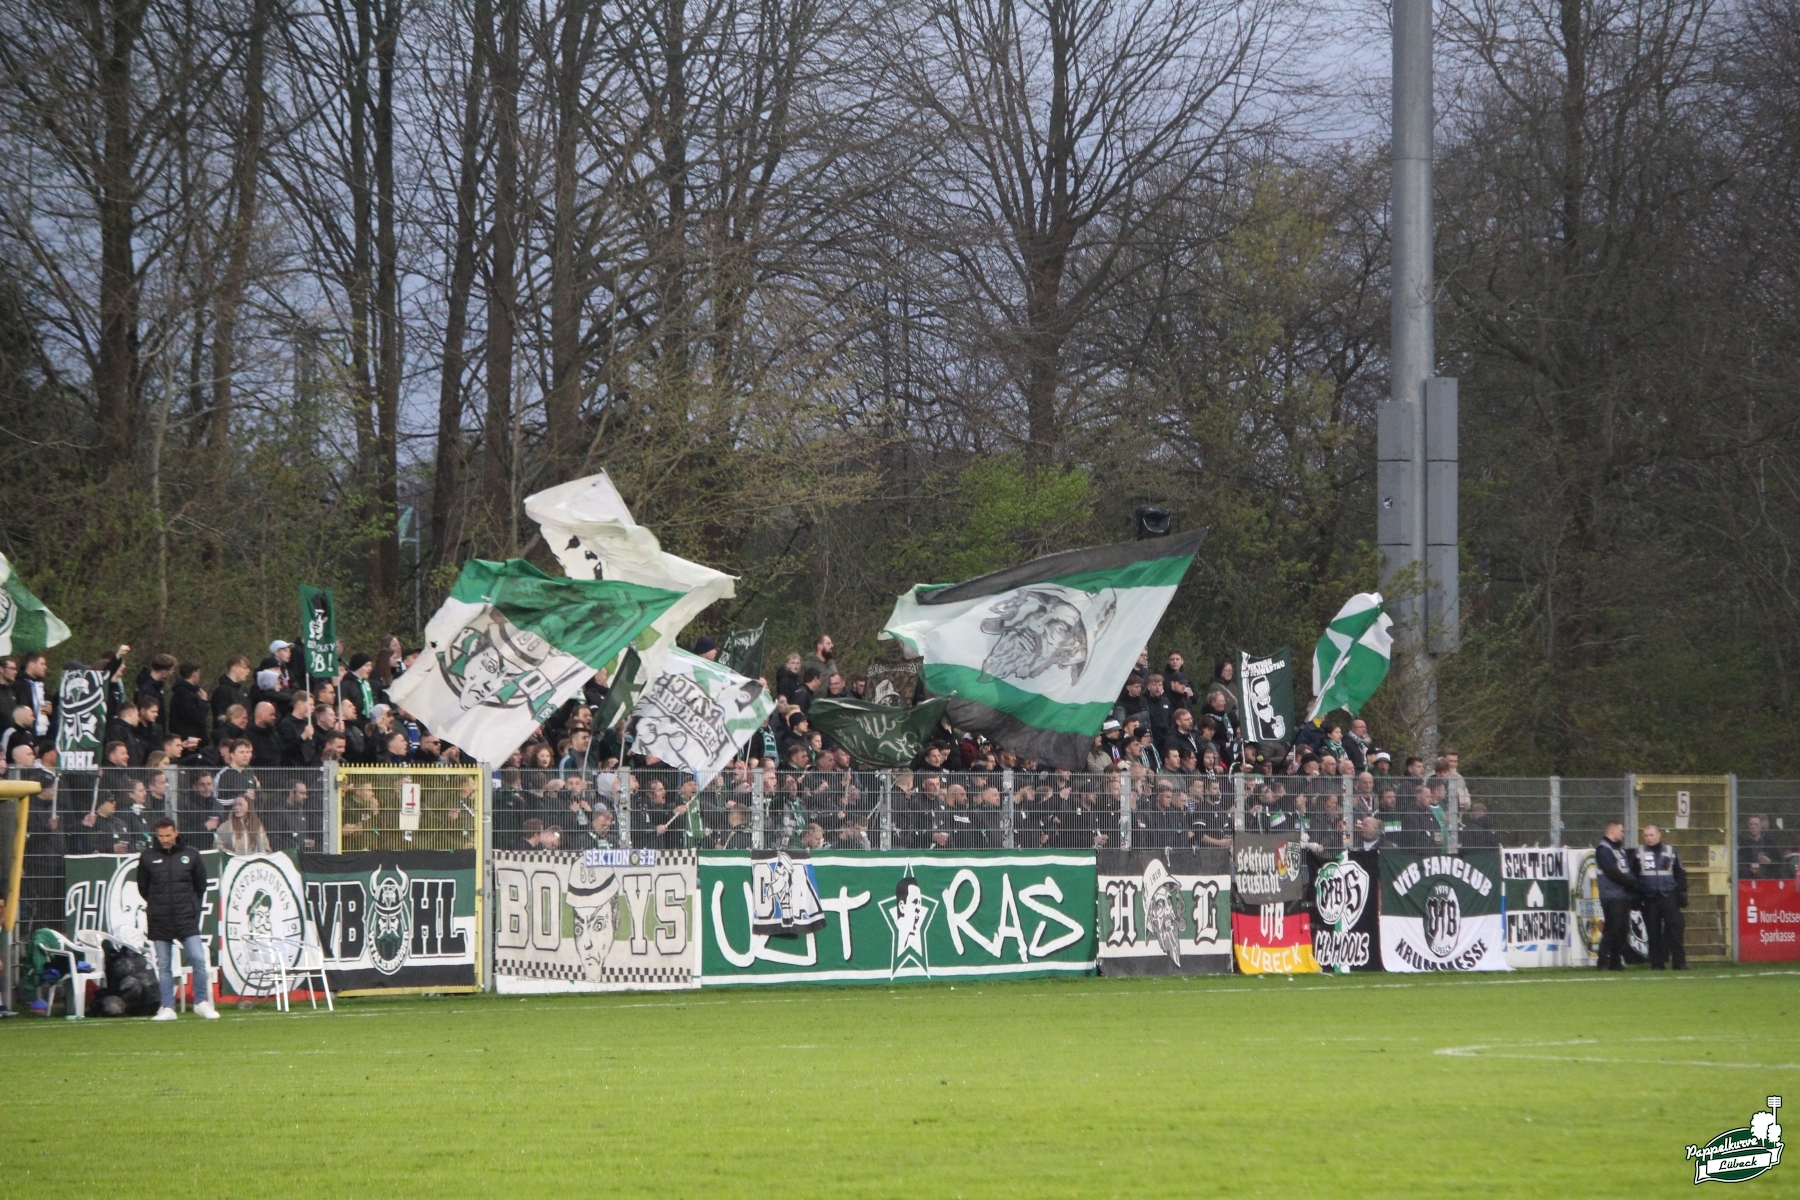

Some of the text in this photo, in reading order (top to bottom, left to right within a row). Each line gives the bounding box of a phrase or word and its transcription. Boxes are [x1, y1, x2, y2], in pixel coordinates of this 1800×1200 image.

[60, 751, 99, 770] VBHL
[1679, 793, 1689, 815] 5
[586, 850, 630, 866] SEKTION
[1238, 846, 1275, 872] sektion
[1644, 860, 1656, 870] 94
[1393, 855, 1493, 896] VfB FANCLUB
[232, 868, 292, 912] KÜSTENJUNGS
[286, 923, 298, 933] 19
[1507, 912, 1567, 944] FLENSBURG
[1760, 929, 1796, 945] Sparkasse
[1241, 937, 1302, 974] LÜBECK
[1394, 938, 1489, 971] KRUMMESSE
